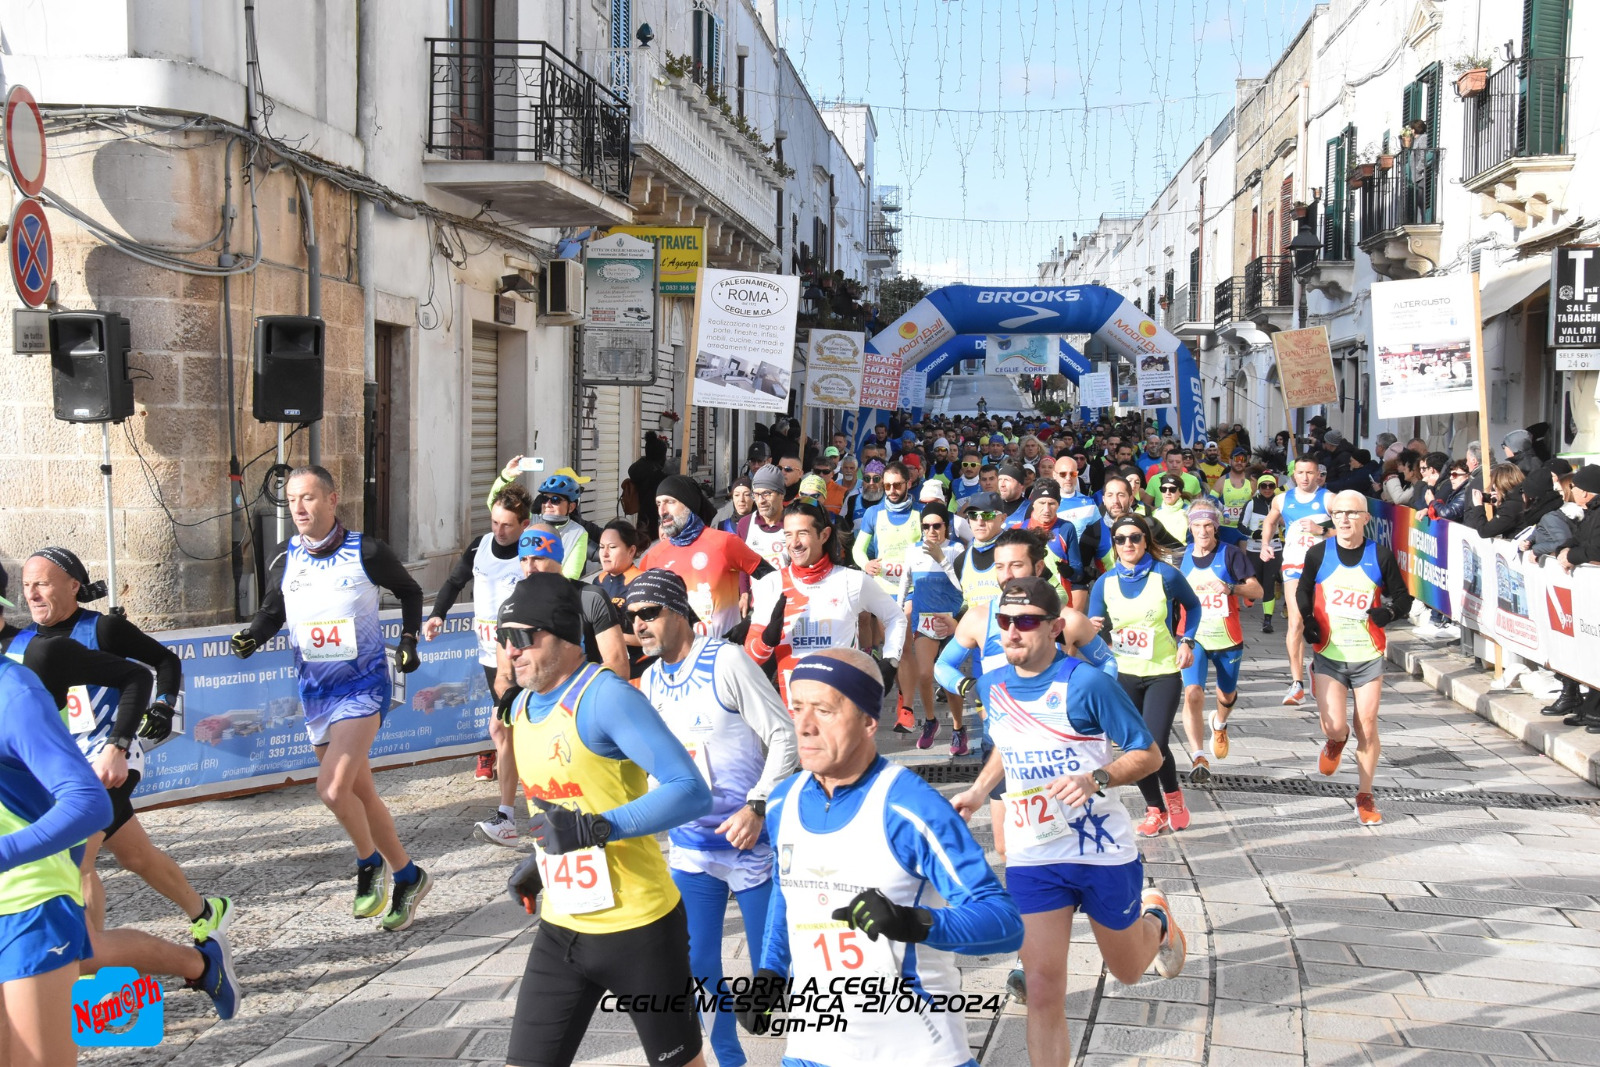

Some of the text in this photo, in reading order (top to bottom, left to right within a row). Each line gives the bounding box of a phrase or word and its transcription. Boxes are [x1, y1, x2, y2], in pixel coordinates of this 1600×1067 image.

[661, 235, 698, 250] TRAVEL
[1568, 250, 1593, 300] T
[720, 278, 781, 294] FALEGNAMERIA
[728, 288, 769, 304] ROMA
[977, 289, 1081, 303] BROOKS
[725, 304, 772, 316] CEGLIE M.CA
[1566, 304, 1592, 312] SALE
[707, 318, 750, 329] Realizzazione
[759, 323, 777, 331] legno
[1114, 319, 1163, 354] MoonBa
[1283, 329, 1321, 340] PANIFICIO
[1561, 327, 1596, 335] VALORI
[1559, 335, 1597, 343] BOLLATI
[707, 341, 748, 351] arredamenti
[761, 347, 783, 355] negozi
[867, 355, 901, 365] SMART
[1567, 360, 1578, 368] 24
[866, 365, 899, 376] SMART
[1291, 368, 1328, 379] PANIFICIO
[864, 376, 898, 387] SMART
[862, 387, 897, 398] SMART
[861, 398, 896, 409] SMART
[1227, 507, 1243, 516] 19
[1332, 589, 1368, 610] 246
[310, 625, 342, 648] 94
[792, 636, 832, 646] SEFIM
[1116, 628, 1148, 648] 198
[464, 649, 479, 659] per
[194, 672, 256, 689] Magazzino
[259, 670, 277, 682] per
[474, 707, 490, 716] 0831
[474, 718, 486, 728] 339
[382, 726, 432, 741] Messapica (BR)
[256, 738, 266, 747] Tel.
[270, 735, 291, 746] 0831
[156, 752, 168, 763] 15
[250, 751, 265, 762] Cell.
[268, 748, 286, 758] 339
[156, 761, 199, 777] Messapica
[201, 758, 219, 770] (BR)
[1011, 795, 1055, 828] 372
[542, 854, 598, 890] 145
[780, 879, 867, 894] ERONAUTICA MILITA
[813, 931, 864, 972] 15
